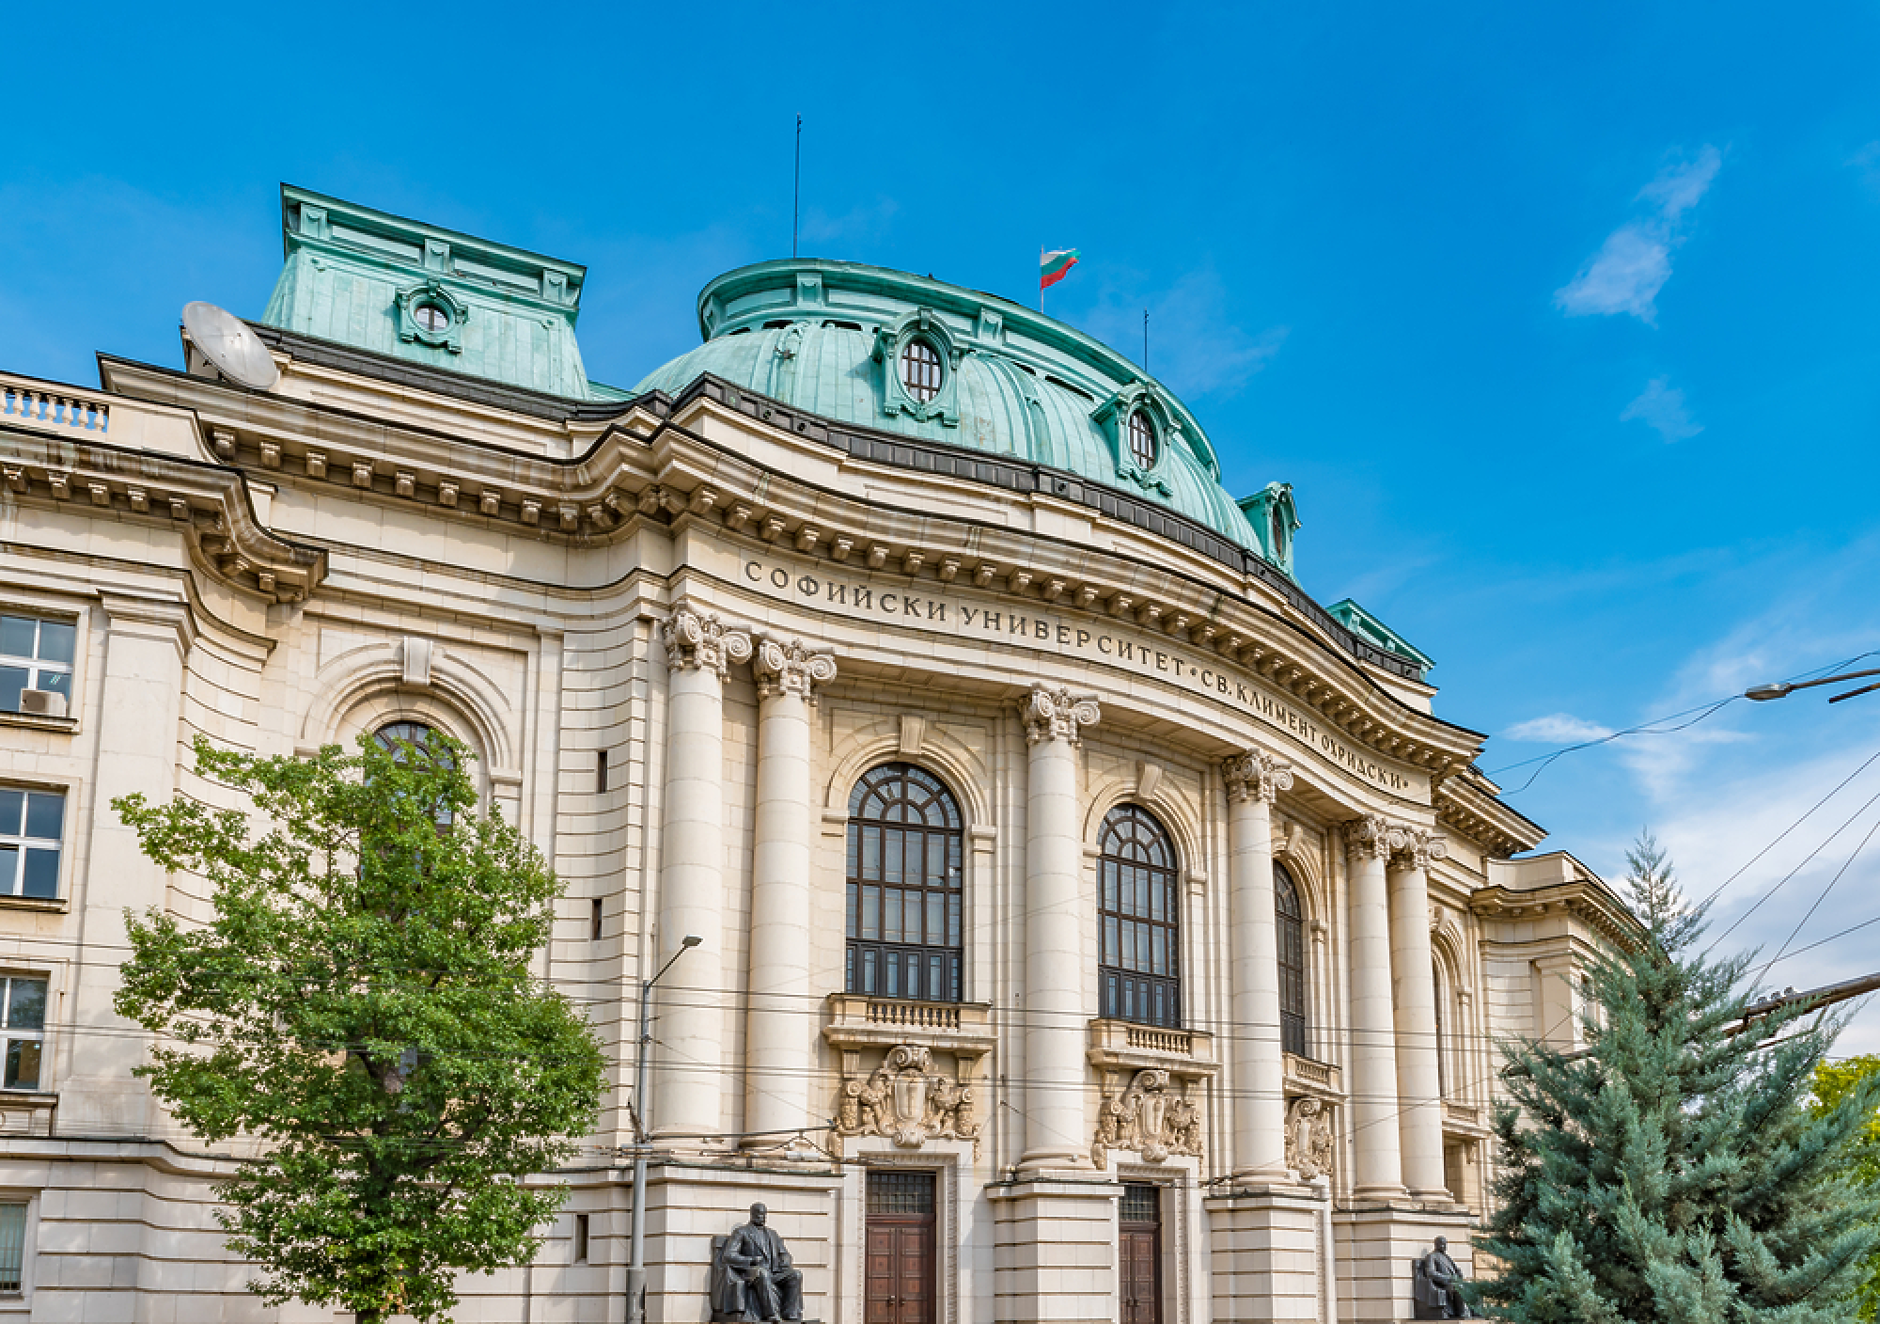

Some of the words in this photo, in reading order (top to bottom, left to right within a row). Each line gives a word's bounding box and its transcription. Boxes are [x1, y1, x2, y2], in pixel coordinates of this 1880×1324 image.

[745, 561, 948, 622] СОФИЙСКИ
[961, 606, 1184, 676] УНИВЕРСИТЕТ
[1237, 682, 1317, 742] КЛИМЕНТ
